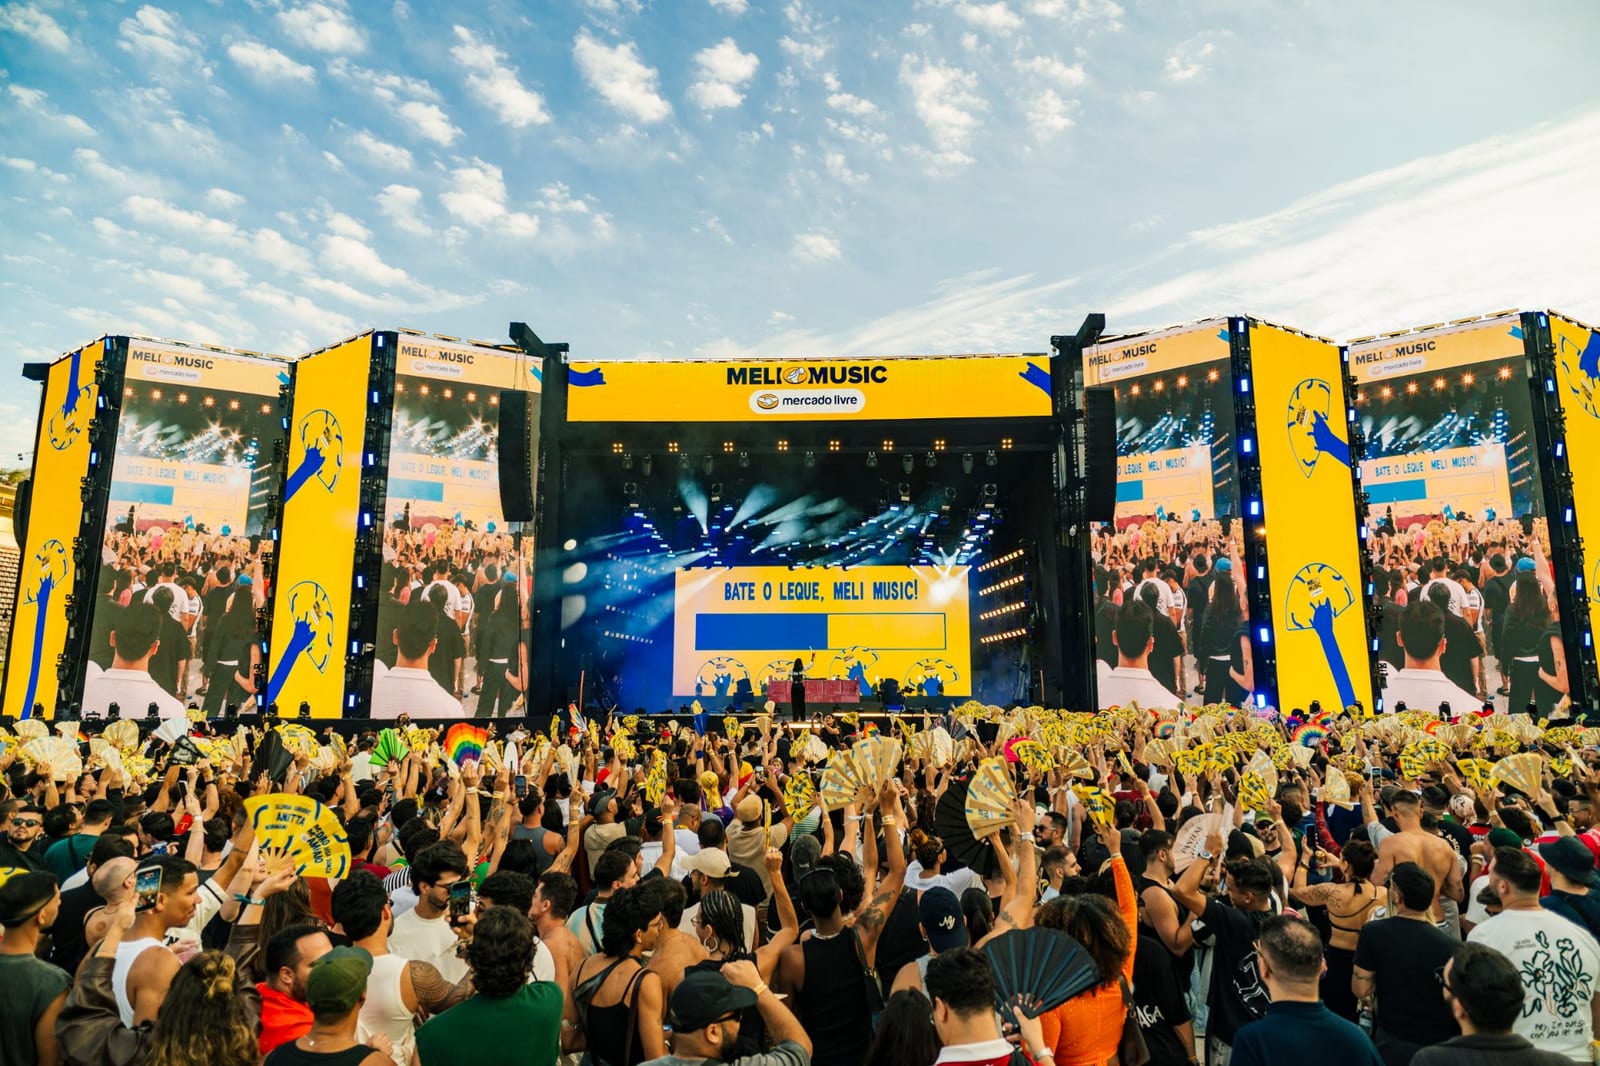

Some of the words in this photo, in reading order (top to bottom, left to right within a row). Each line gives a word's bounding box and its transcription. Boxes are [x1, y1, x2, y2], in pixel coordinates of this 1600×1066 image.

[132, 350, 161, 363] MELI
[174, 355, 214, 370] MUSIC
[401, 346, 427, 358] MELI
[439, 351, 474, 364] MUSIC
[1089, 353, 1112, 367] MELI
[1122, 343, 1157, 360] MUSIC
[1355, 352, 1383, 365] MELI
[1395, 341, 1436, 358] MUSIC
[726, 367, 782, 385] MELI
[808, 366, 888, 384] MUSIC
[782, 395, 832, 406] mercado
[834, 394, 858, 405] livre
[1148, 461, 1162, 471] MELI
[1375, 465, 1391, 477] BATE
[1394, 464, 1399, 474] O
[1431, 459, 1447, 470] MELI
[724, 582, 756, 601] BATE
[763, 582, 772, 601] O
[779, 582, 825, 602] LEQUE,
[833, 582, 864, 600] MELI
[873, 579, 918, 600] MUSIC!
[276, 812, 306, 826] ANITTA
